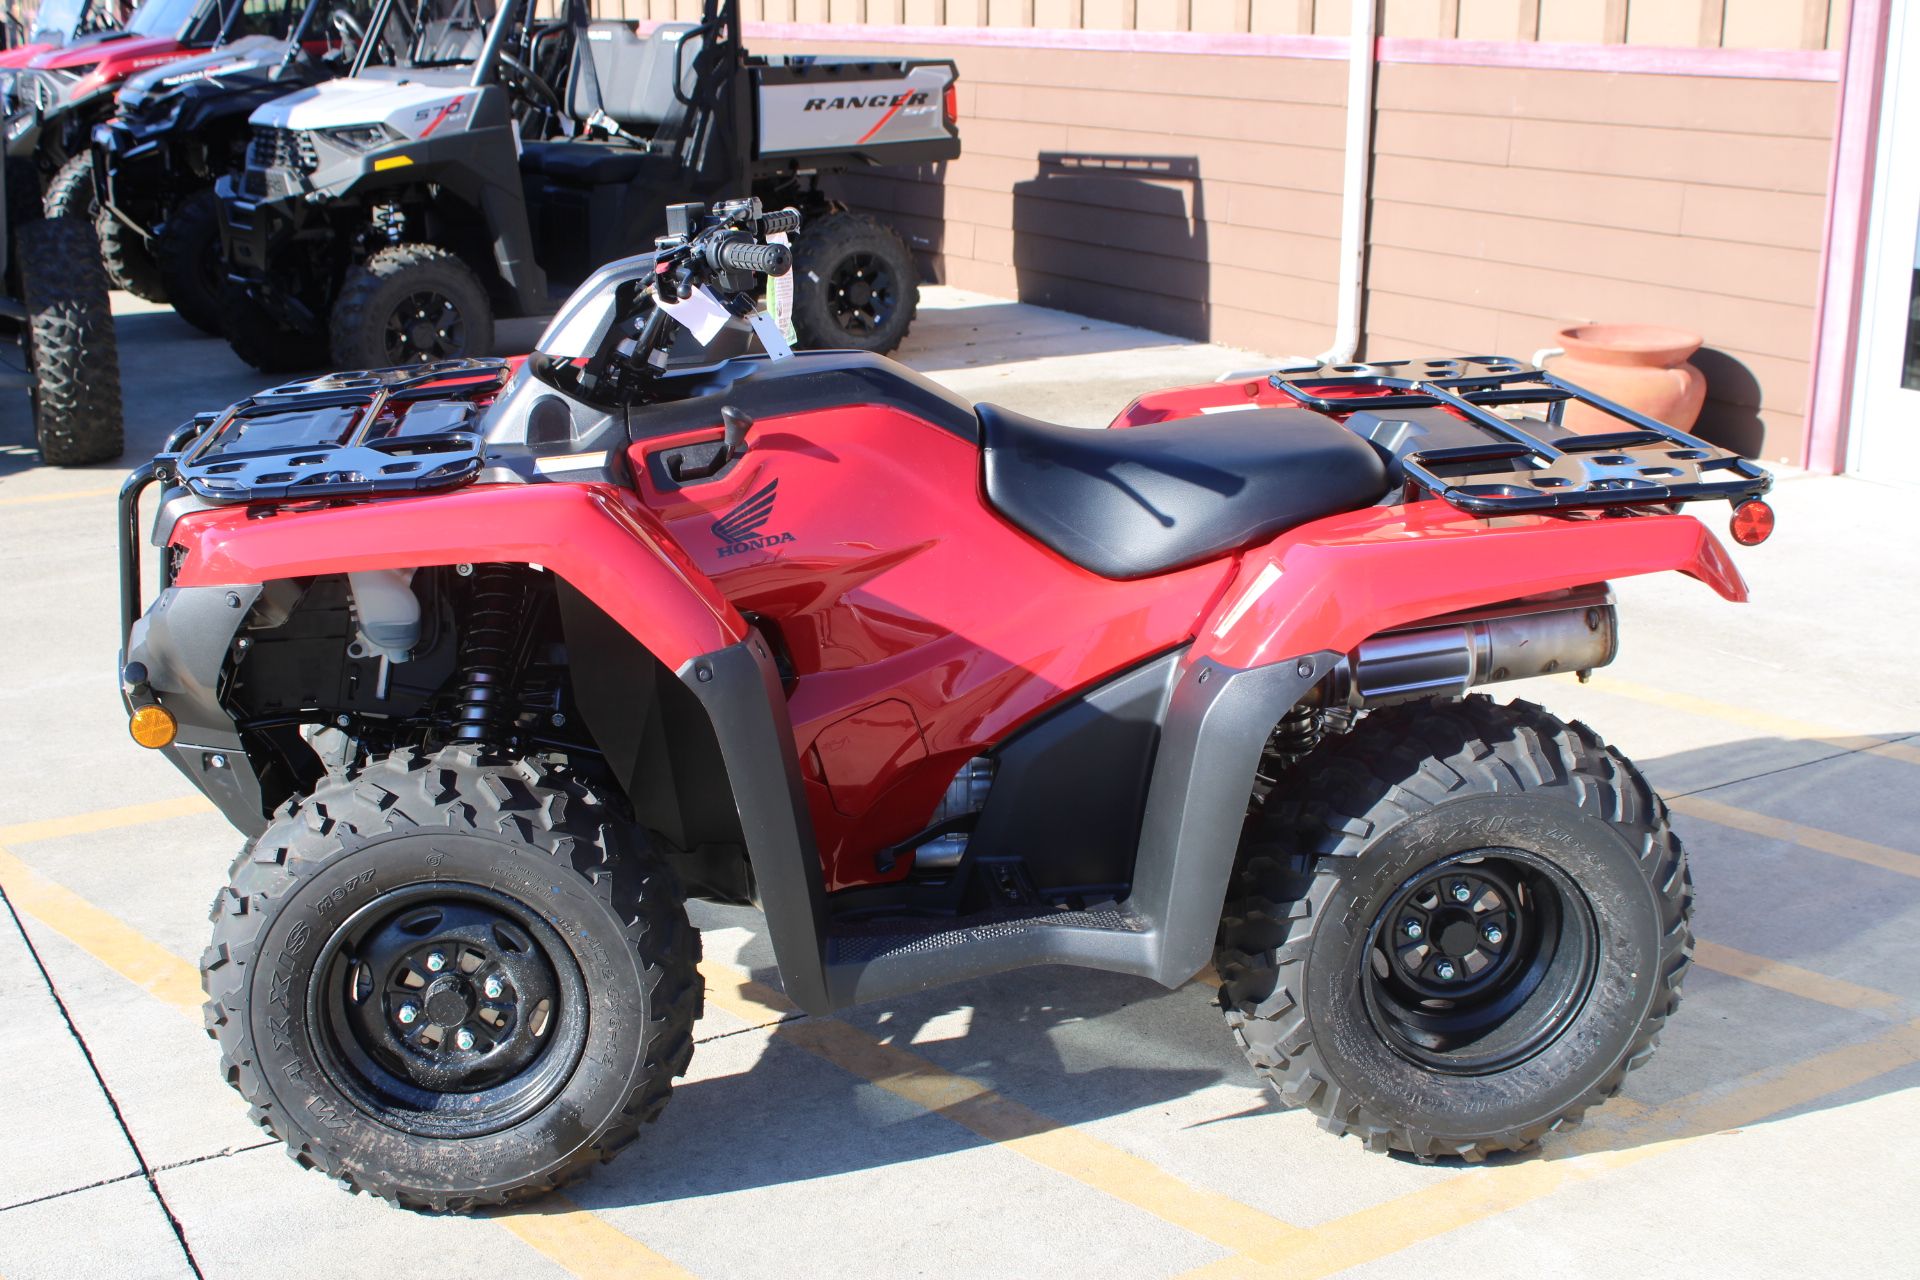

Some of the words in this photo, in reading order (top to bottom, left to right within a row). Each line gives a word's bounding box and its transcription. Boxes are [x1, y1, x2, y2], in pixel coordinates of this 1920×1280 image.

[414, 102, 462, 121] 570
[803, 92, 928, 111] RANGER
[716, 531, 797, 559] HONDA
[315, 867, 377, 916] M977
[269, 920, 352, 1130] MAXXIS
